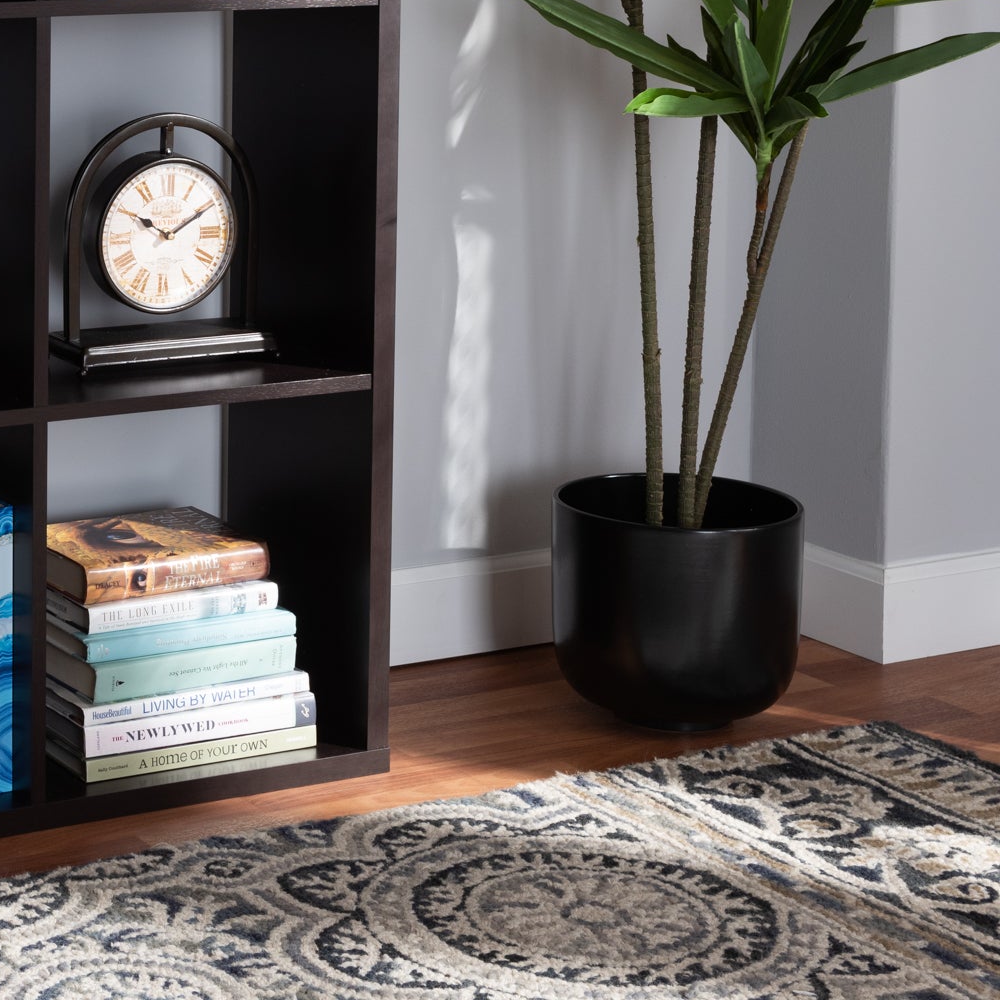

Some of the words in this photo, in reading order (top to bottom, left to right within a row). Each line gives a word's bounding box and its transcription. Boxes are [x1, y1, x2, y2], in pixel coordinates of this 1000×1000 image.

[190, 554, 220, 571] FIRE
[164, 570, 222, 590] ETERNAL
[102, 610, 123, 623] THE
[129, 604, 157, 619] LONG
[162, 600, 195, 614] EXILE
[180, 666, 202, 676] Cannot
[142, 697, 186, 714] LIVING
[190, 694, 207, 706] BY
[212, 686, 256, 702] WATER
[125, 720, 216, 742] NEWLYWED
[139, 759, 148, 770] A
[190, 749, 204, 760] OF
[240, 739, 268, 752] OWN
